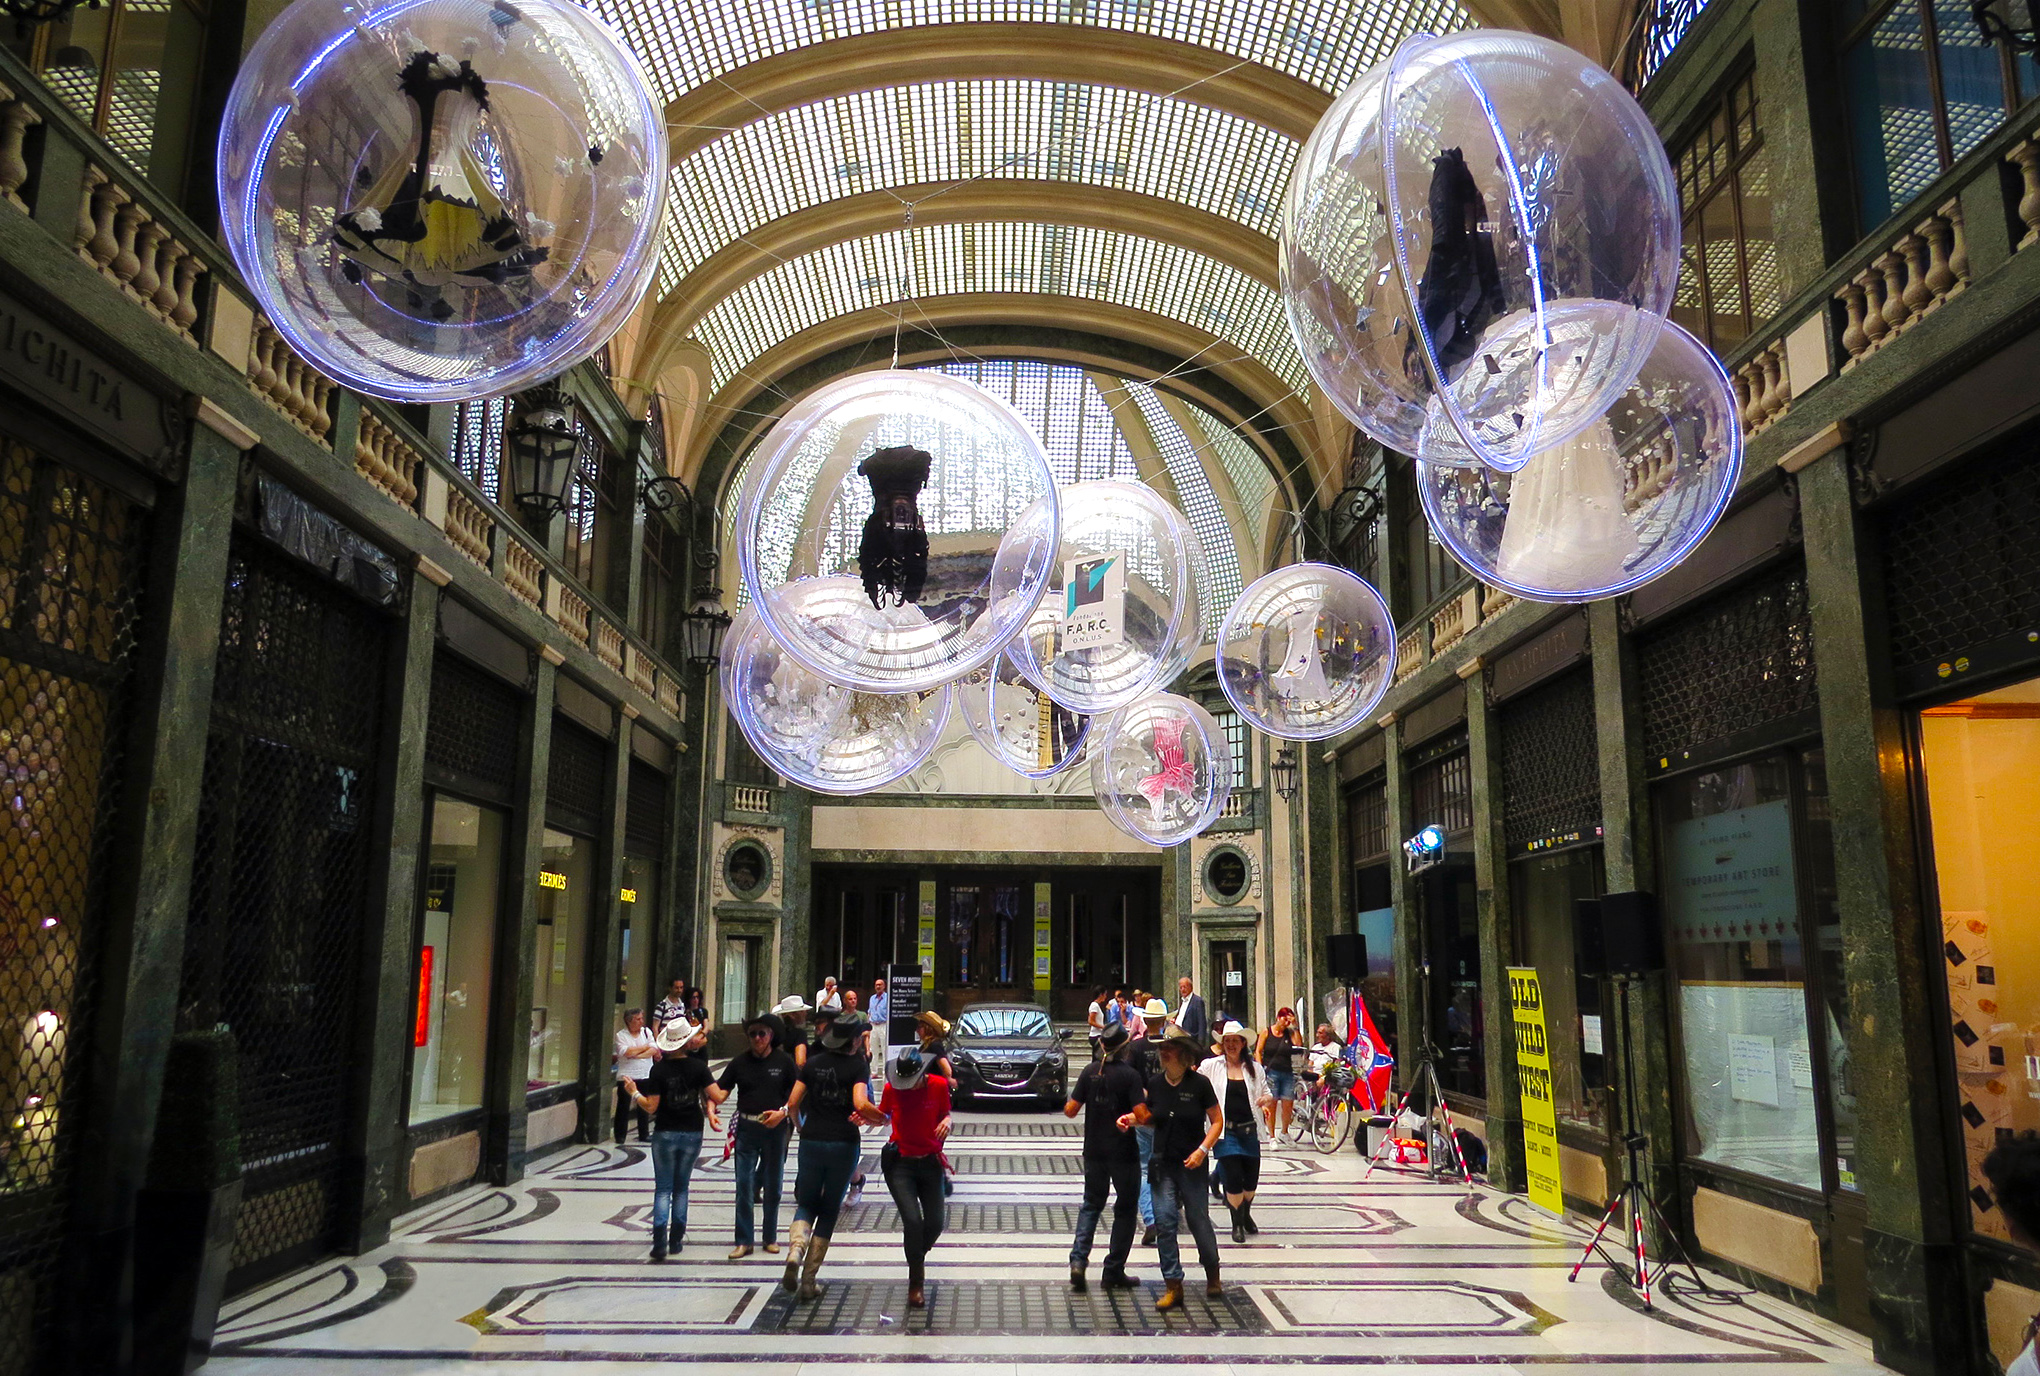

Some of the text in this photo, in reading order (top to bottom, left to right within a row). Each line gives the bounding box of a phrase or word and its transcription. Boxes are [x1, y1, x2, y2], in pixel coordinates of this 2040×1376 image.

[0, 308, 123, 421] ICHITÀ
[1511, 977, 1540, 1011] OLD
[1515, 1020, 1545, 1056] WILD
[1518, 1064, 1550, 1103] WEST
